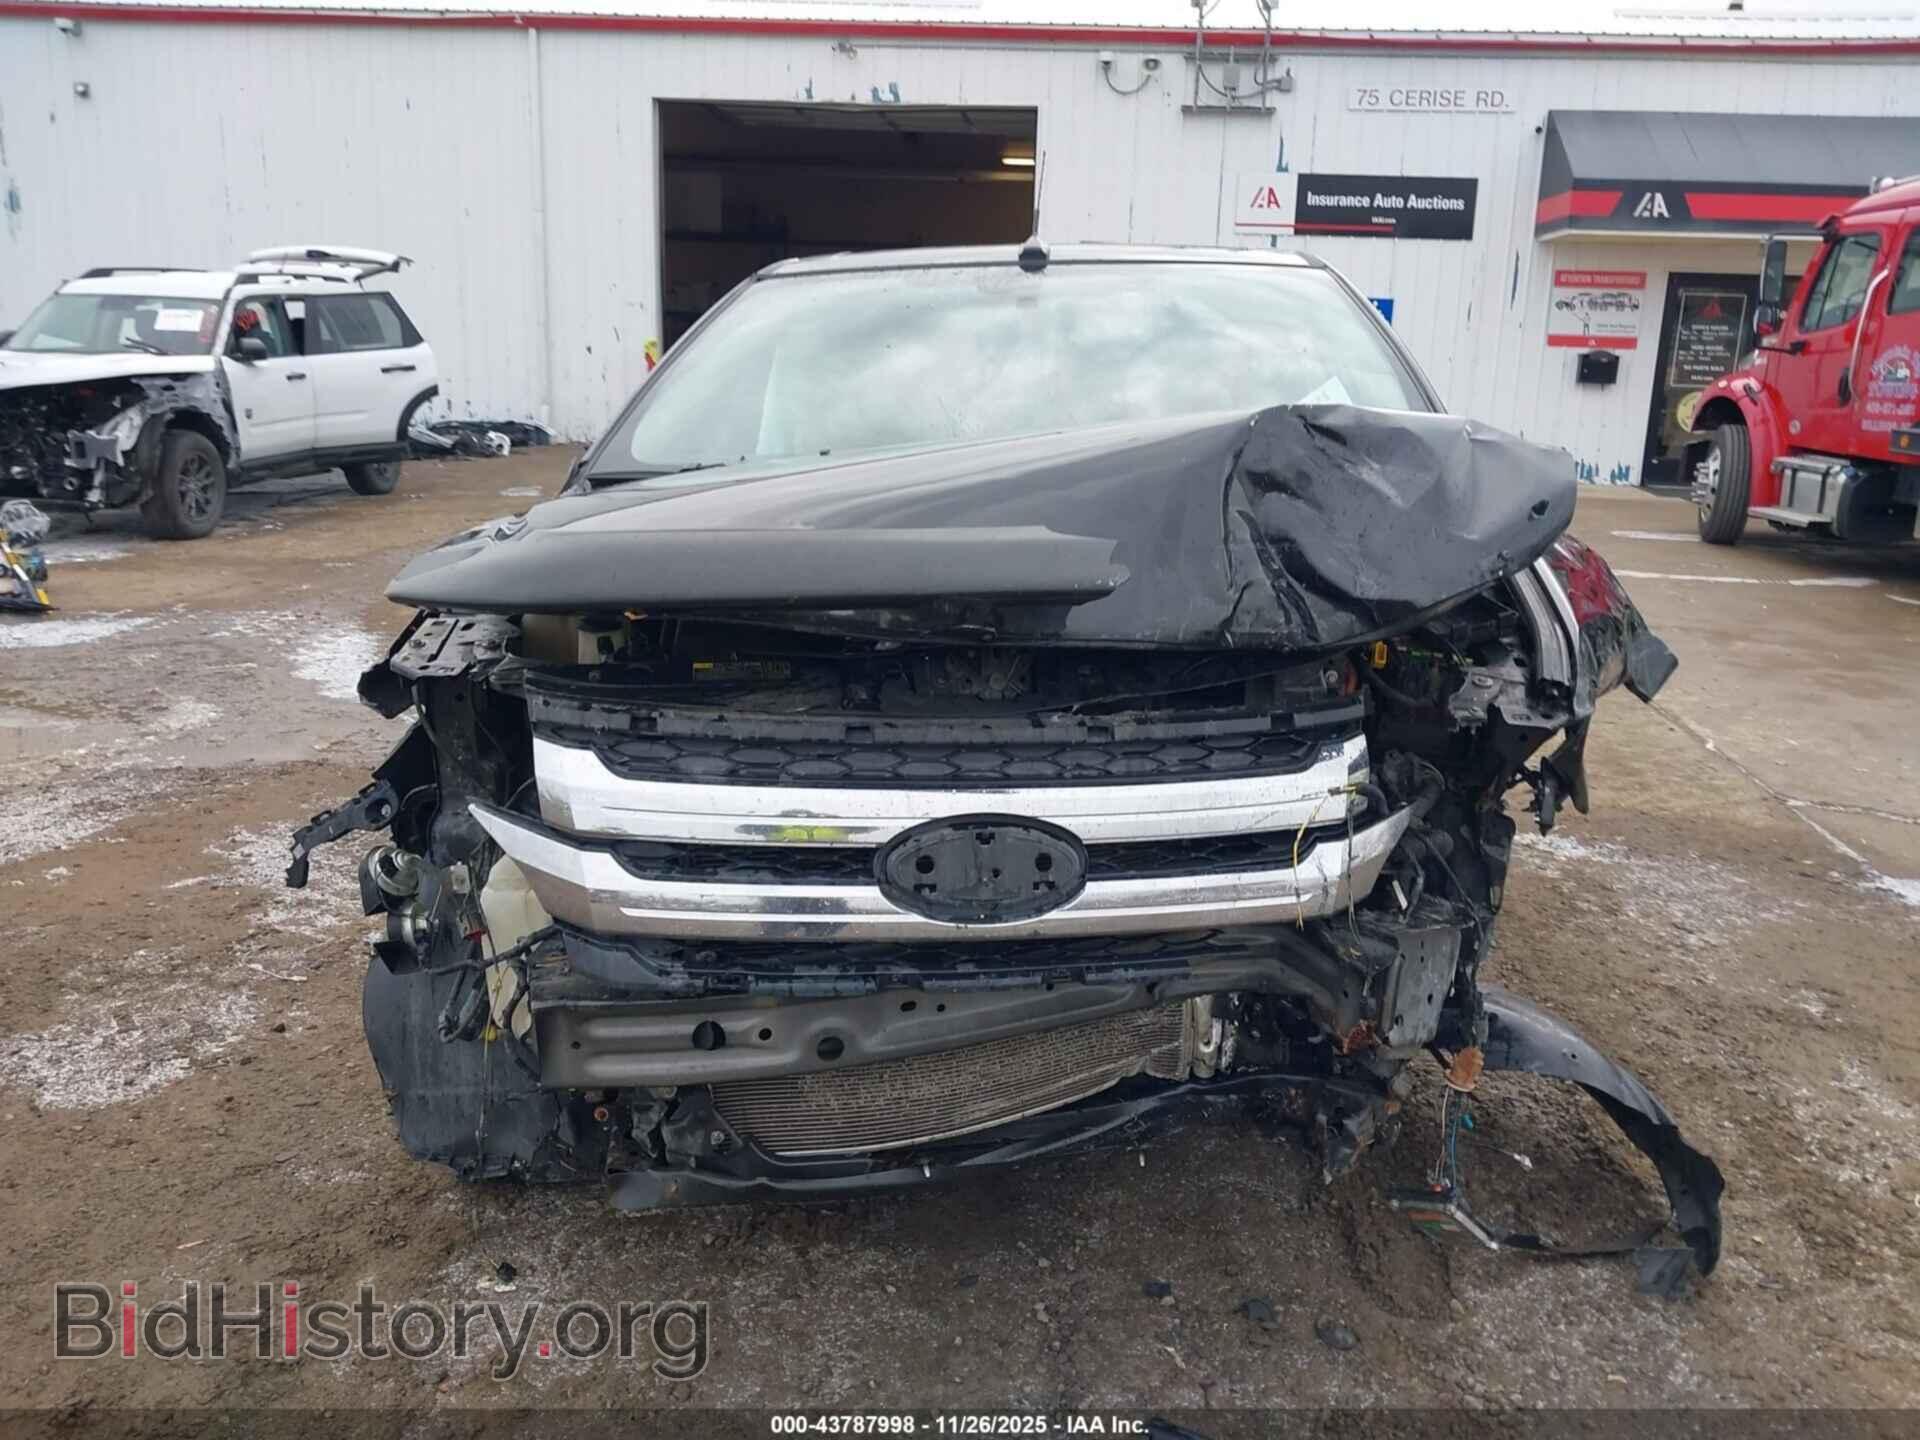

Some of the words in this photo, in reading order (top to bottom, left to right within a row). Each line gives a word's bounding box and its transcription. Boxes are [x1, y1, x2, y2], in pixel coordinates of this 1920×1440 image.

[1355, 89, 1380, 107] 75
[1389, 89, 1465, 108] CERISE
[1475, 90, 1509, 108] RD.
[1306, 191, 1371, 209] Insurance
[1373, 192, 1405, 209] Auto
[1406, 194, 1465, 211] Auctions
